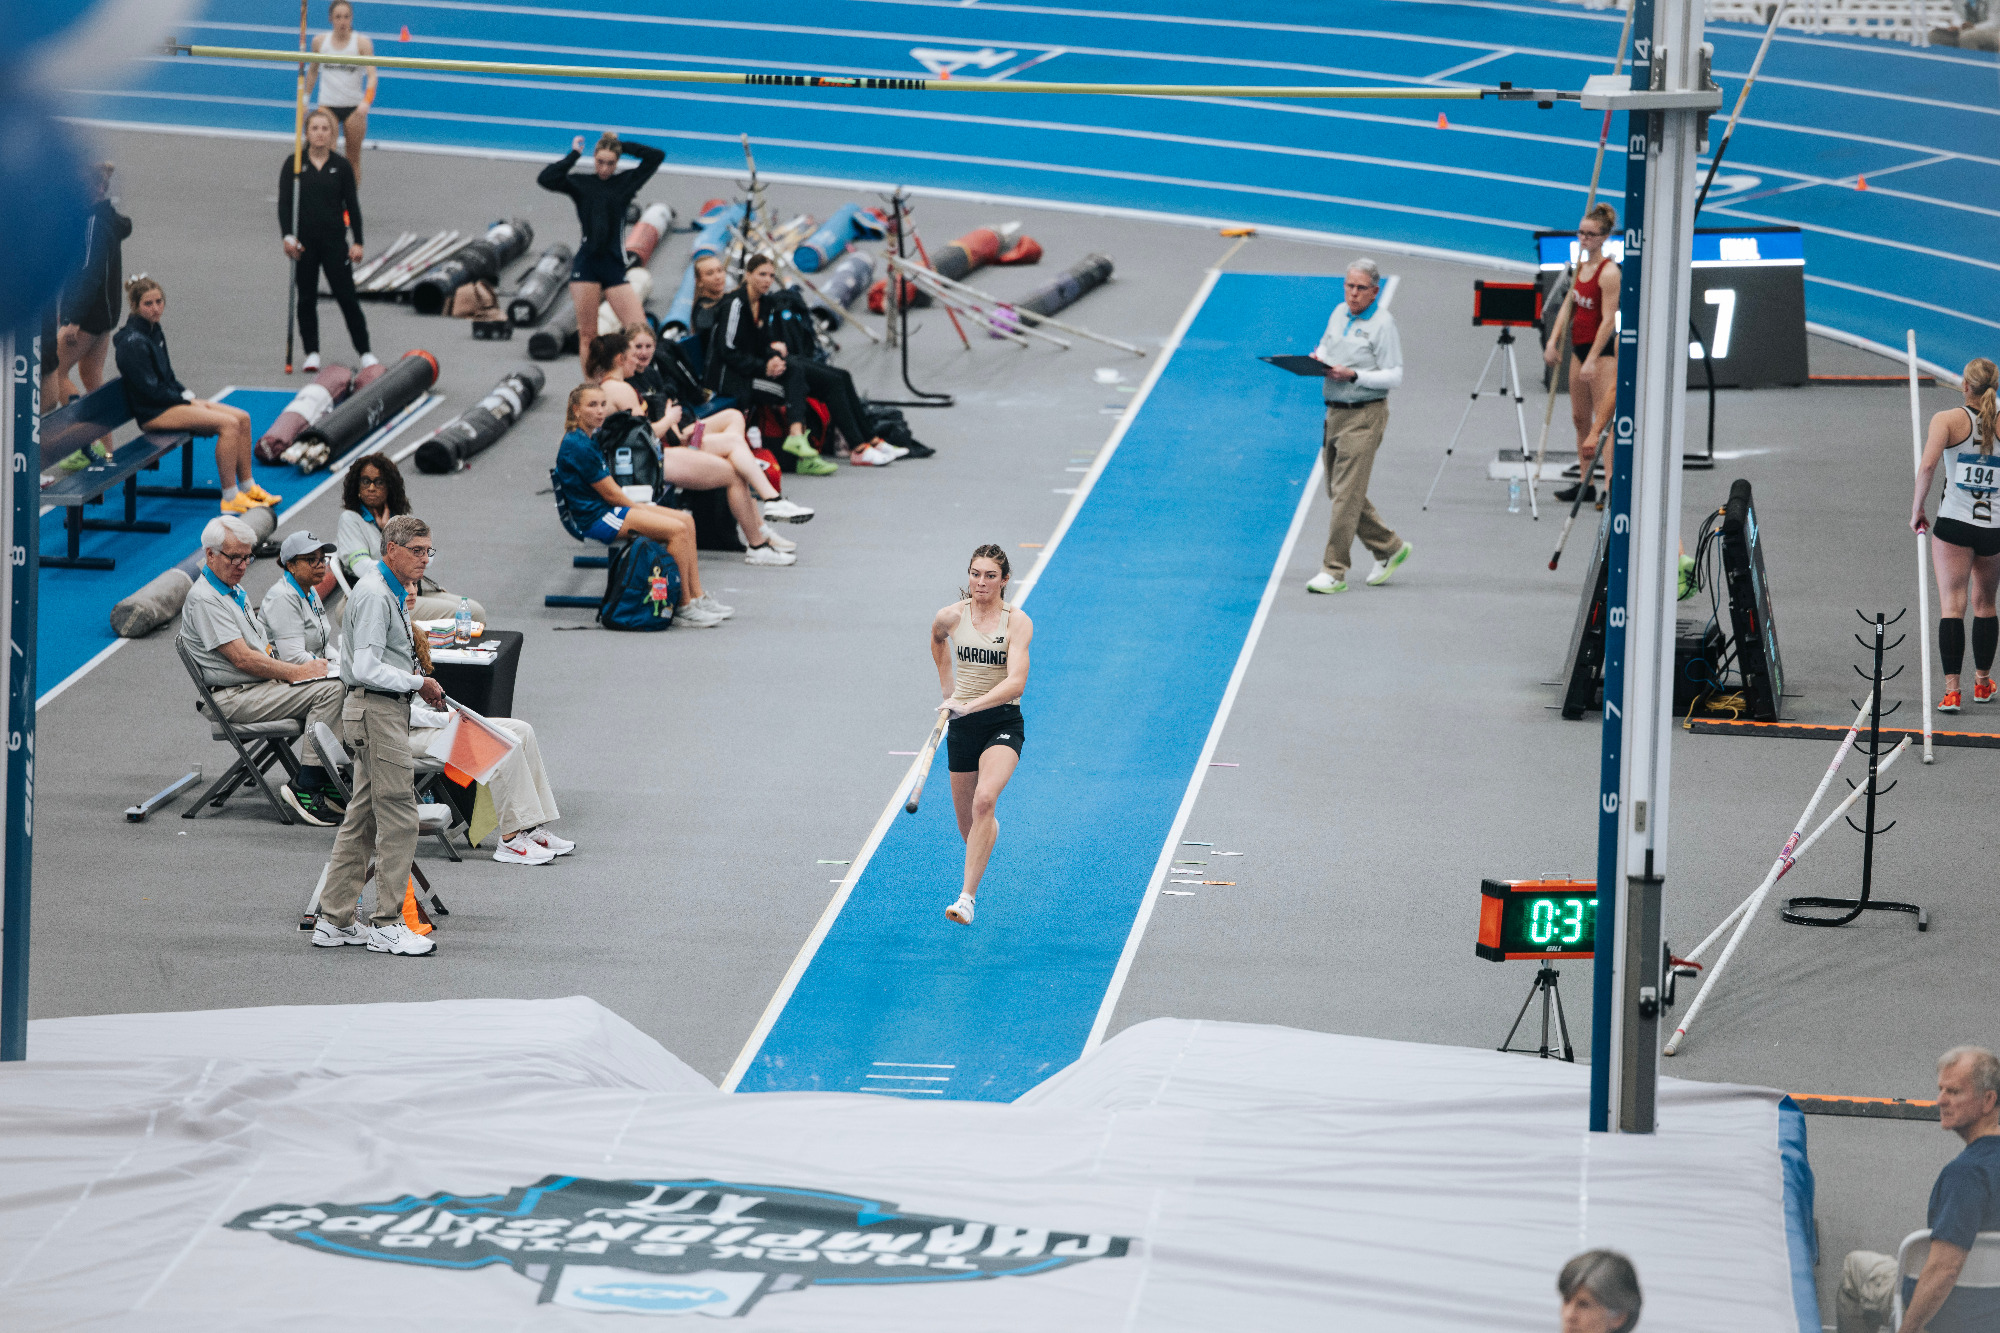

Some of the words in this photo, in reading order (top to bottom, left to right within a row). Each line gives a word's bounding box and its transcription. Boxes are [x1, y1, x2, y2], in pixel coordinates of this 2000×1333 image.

[1633, 36, 1652, 67] 14
[1628, 133, 1647, 161] 13
[1624, 228, 1642, 256] 12
[1620, 328, 1638, 344] 11
[14, 354, 28, 384] 10
[32, 335, 41, 444] NCAA
[1616, 415, 1634, 446] 10
[13, 452, 27, 473] 9
[1963, 466, 1994, 485] 194
[1613, 512, 1630, 535] 9
[12, 545, 26, 567] 8
[1609, 605, 1626, 628] 8
[957, 645, 1007, 665] HARDING
[1605, 699, 1621, 720] 7
[8, 730, 22, 752] 6
[25, 730, 34, 838] GILL
[1602, 791, 1618, 813] 6
[1531, 899, 1599, 942] 0:3
[249, 1206, 1111, 1257] CHAMPIONSHIPS
[710, 1245, 979, 1270] TRACK
